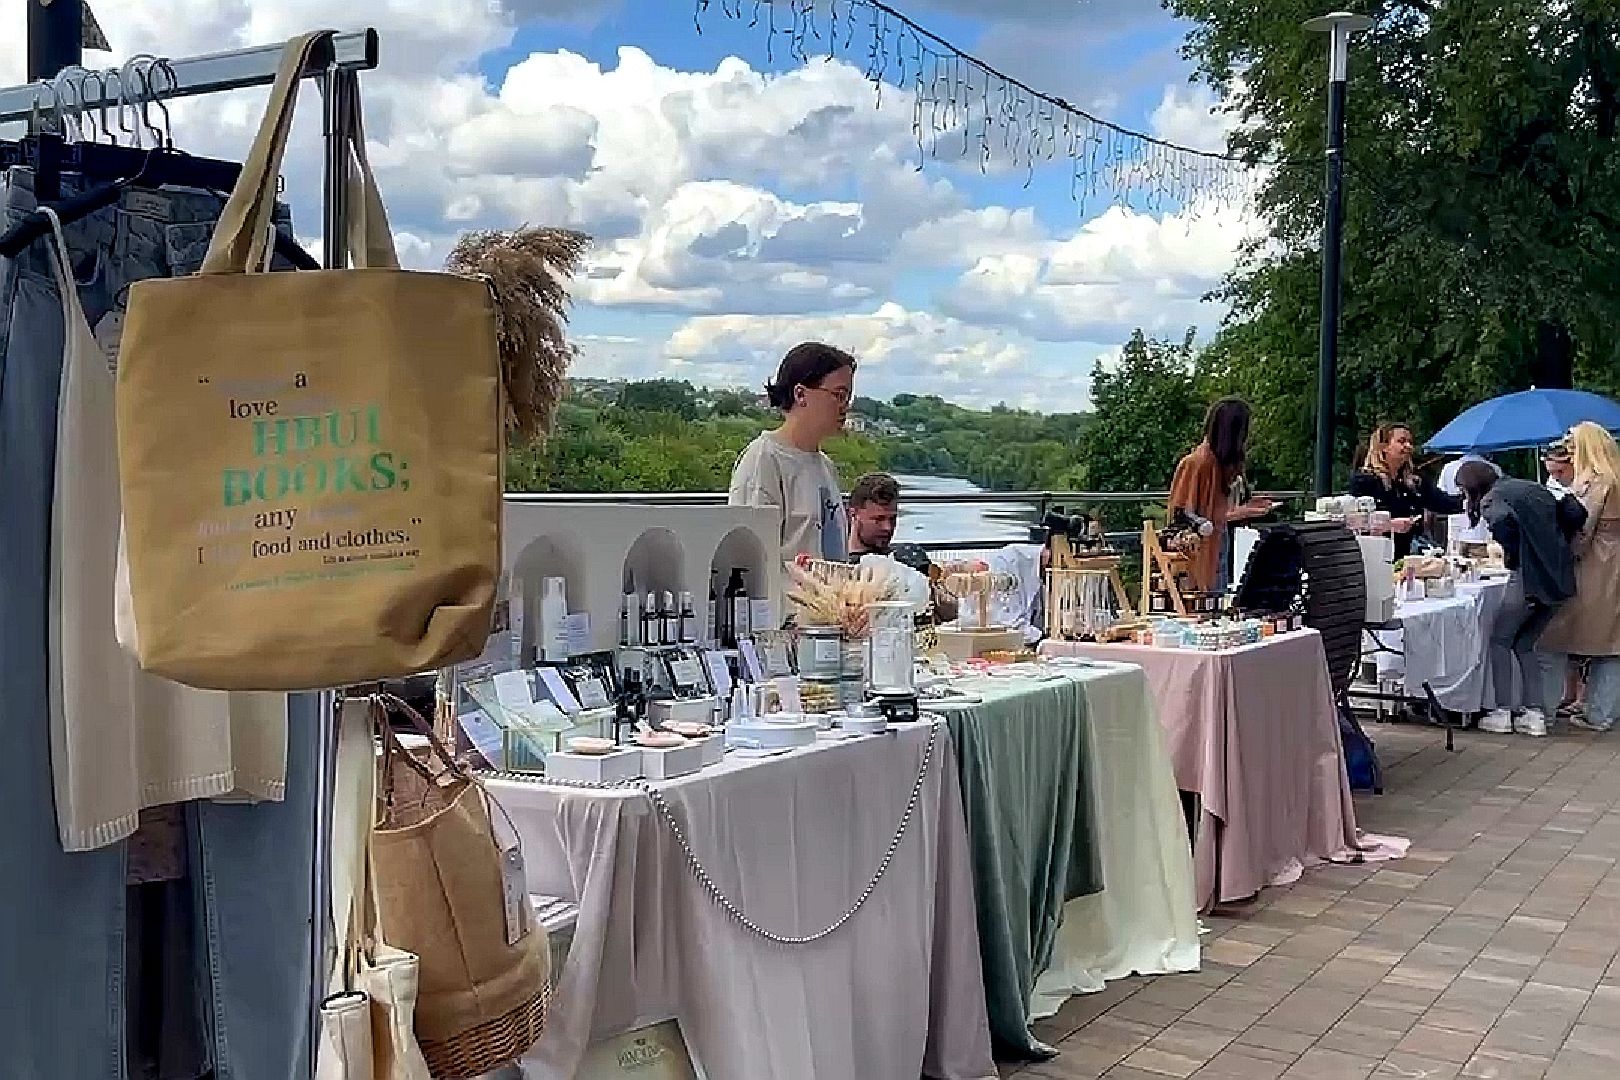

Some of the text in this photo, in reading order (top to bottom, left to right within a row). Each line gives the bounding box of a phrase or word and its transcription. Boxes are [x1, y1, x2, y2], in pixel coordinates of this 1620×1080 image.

[229, 399, 279, 419] love
[254, 508, 298, 530] any
[252, 535, 292, 559] food
[297, 531, 331, 551] and
